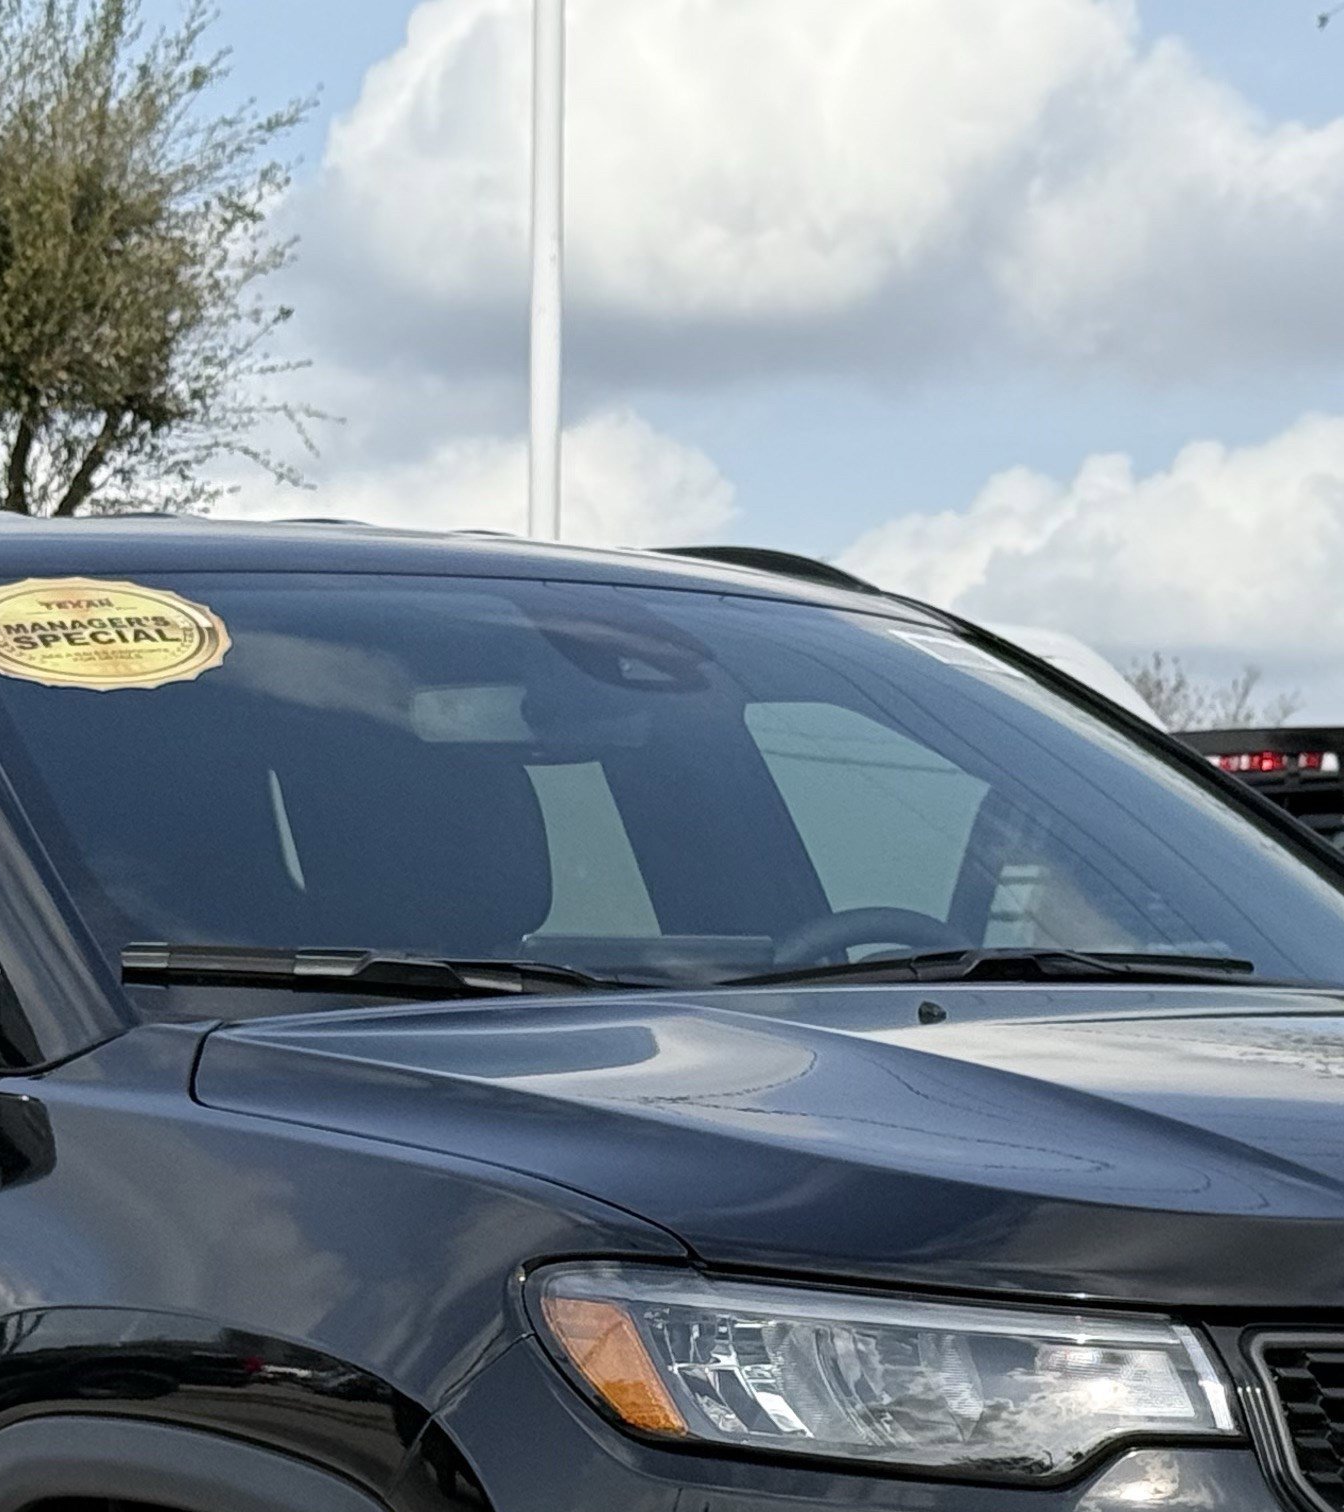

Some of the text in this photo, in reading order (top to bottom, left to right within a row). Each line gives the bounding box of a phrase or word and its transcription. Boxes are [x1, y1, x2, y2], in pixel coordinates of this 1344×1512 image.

[36, 598, 114, 611] TEXAN
[3, 615, 171, 635] MANAGER'S
[13, 628, 184, 651] SPECIAL
